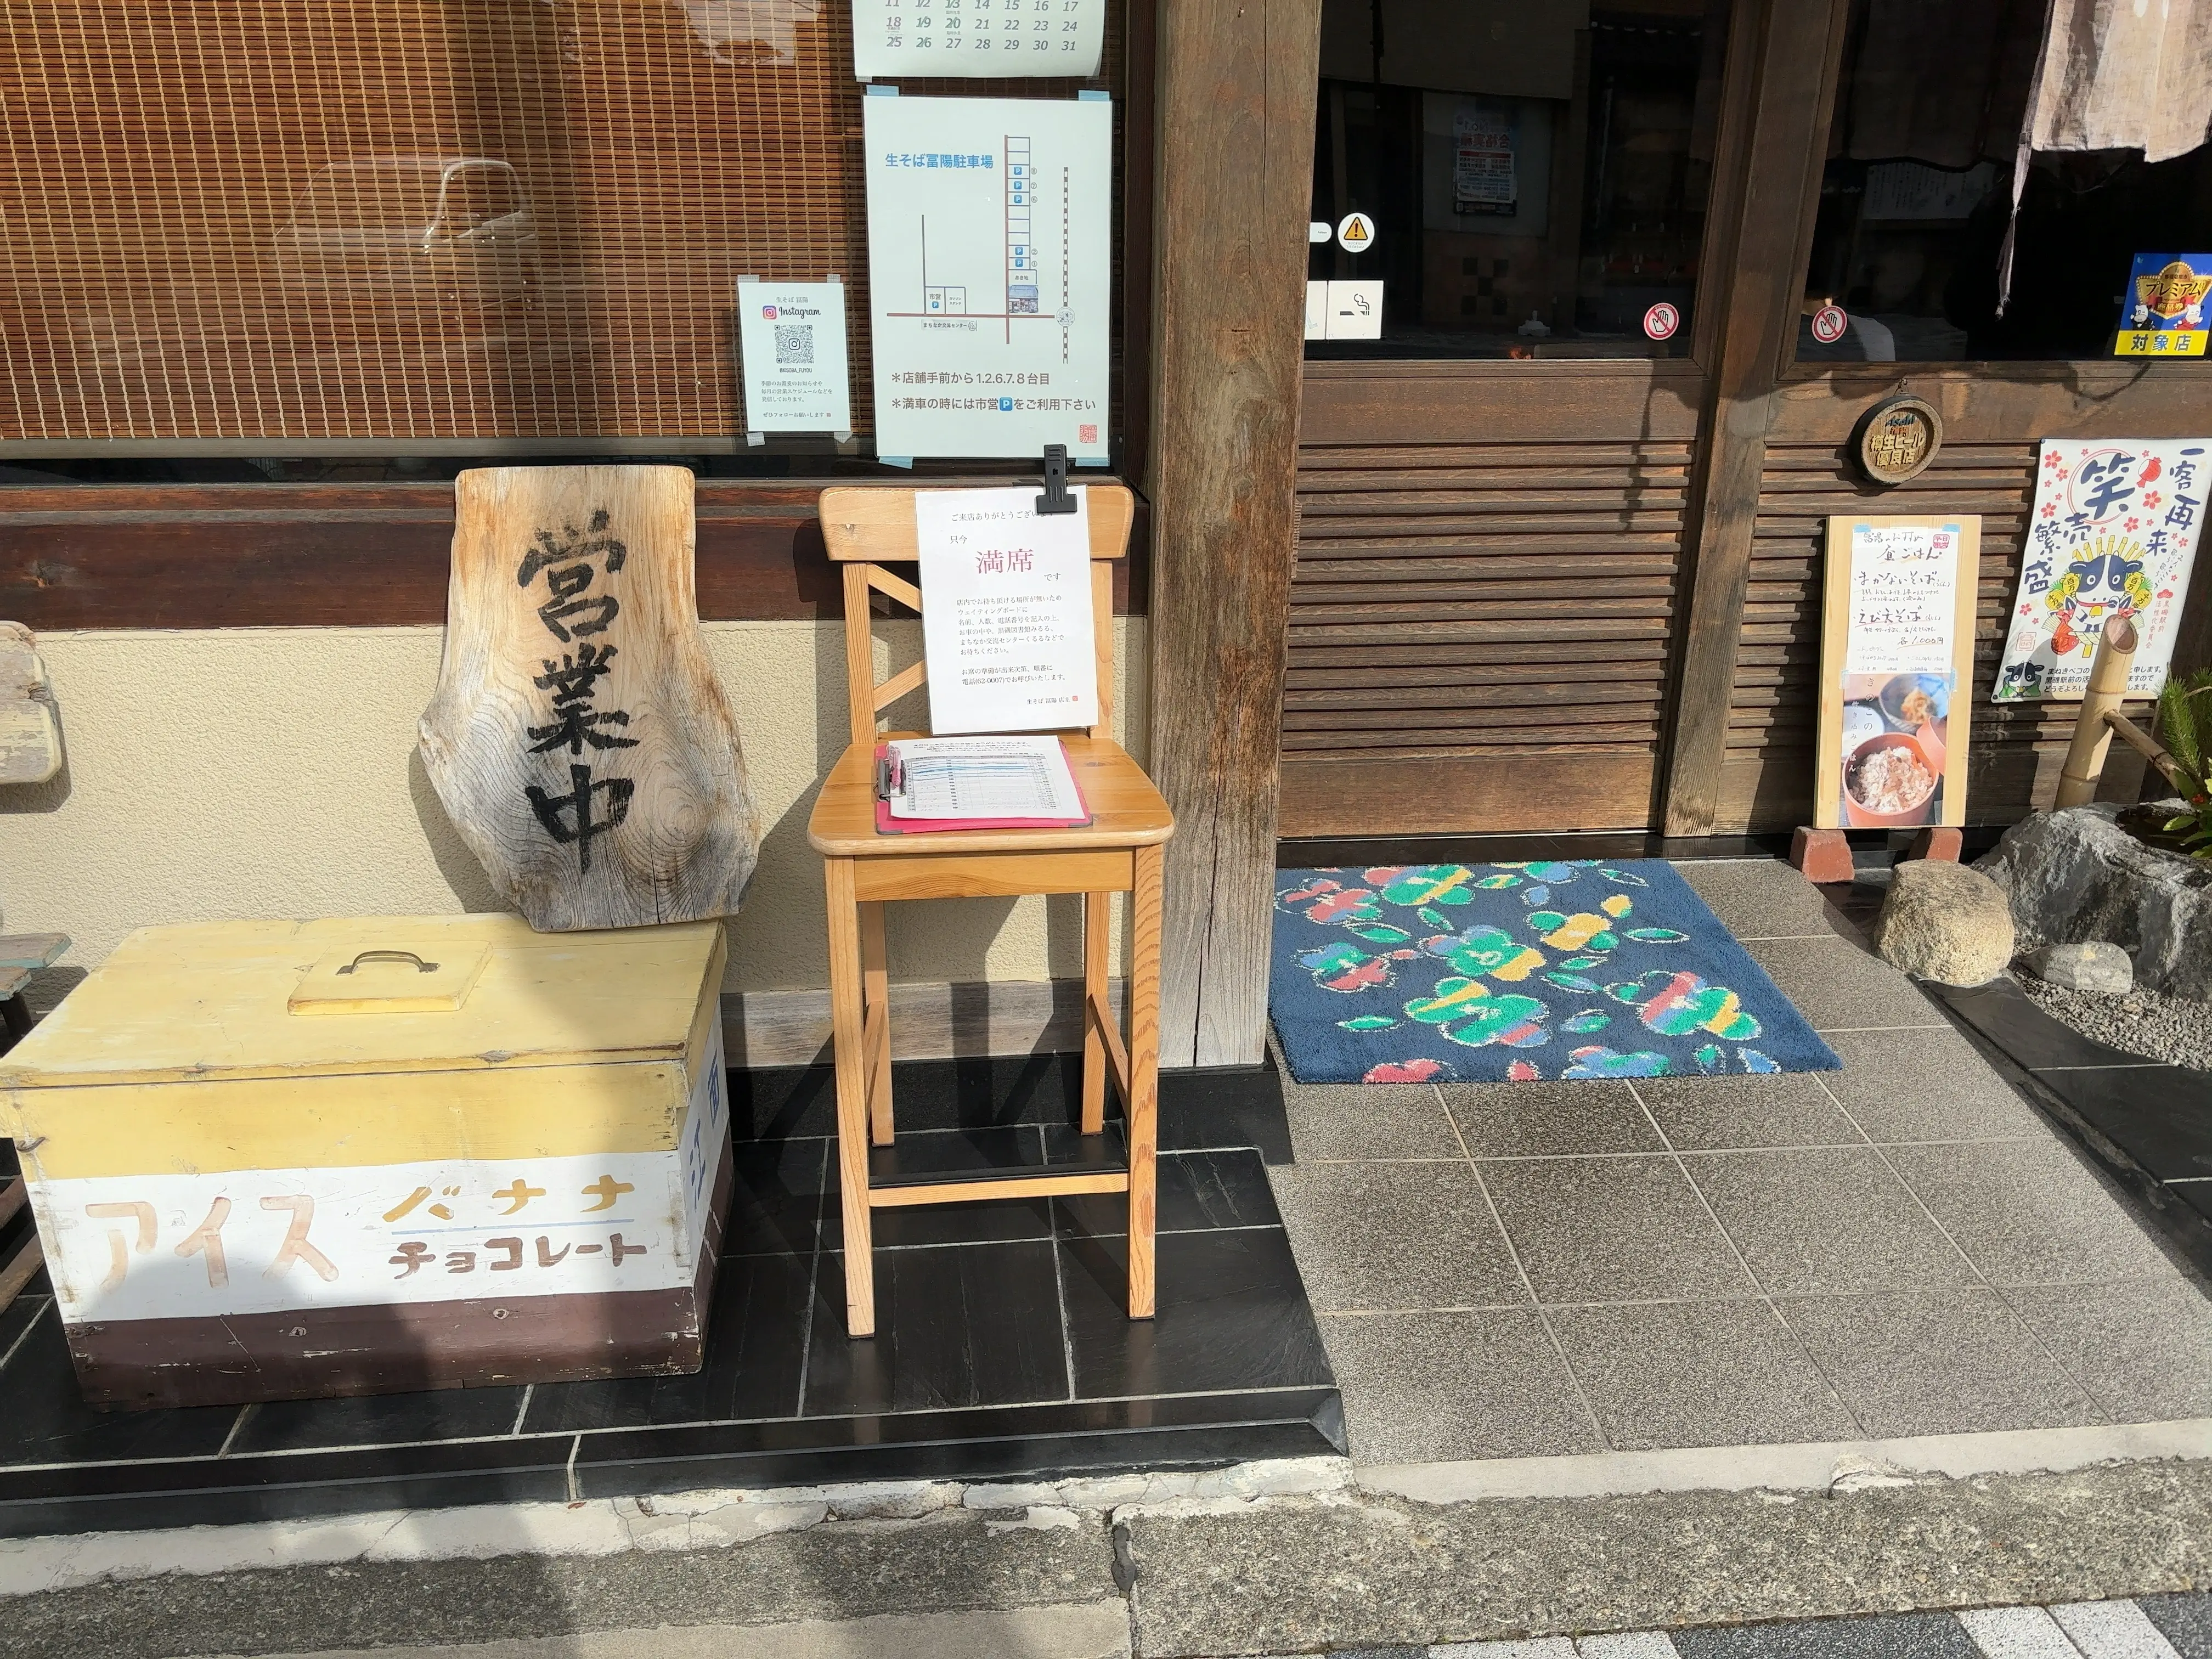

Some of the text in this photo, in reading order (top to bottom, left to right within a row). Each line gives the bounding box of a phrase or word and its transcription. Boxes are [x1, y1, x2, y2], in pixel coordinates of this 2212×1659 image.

[975, 0, 990, 9] 14
[1005, 0, 1020, 10] 15
[1034, 0, 1049, 11] 16
[1063, 1, 1078, 12] 17
[886, 16, 901, 27] 18
[974, 19, 989, 29] 21
[1004, 20, 1019, 30] 22
[1033, 20, 1048, 31] 23
[1062, 21, 1077, 31] 24
[945, 38, 962, 48] 27
[975, 39, 990, 49] 28
[1004, 40, 1019, 50] 29
[1032, 40, 1048, 50] 30
[1061, 41, 1076, 50] 31
[2146, 280, 2201, 297] プレミアム
[778, 306, 821, 319] Instagram
[2131, 334, 2192, 351] 対象店
[1876, 448, 1916, 467] 優良店
[950, 535, 968, 544] 只今
[975, 549, 1035, 574] 満席
[1043, 572, 1061, 581] です
[517, 509, 640, 874] 営業中
[382, 1173, 636, 1222] バナナ
[85, 1195, 339, 1291] アイス
[388, 1233, 647, 1280] チョコレート
